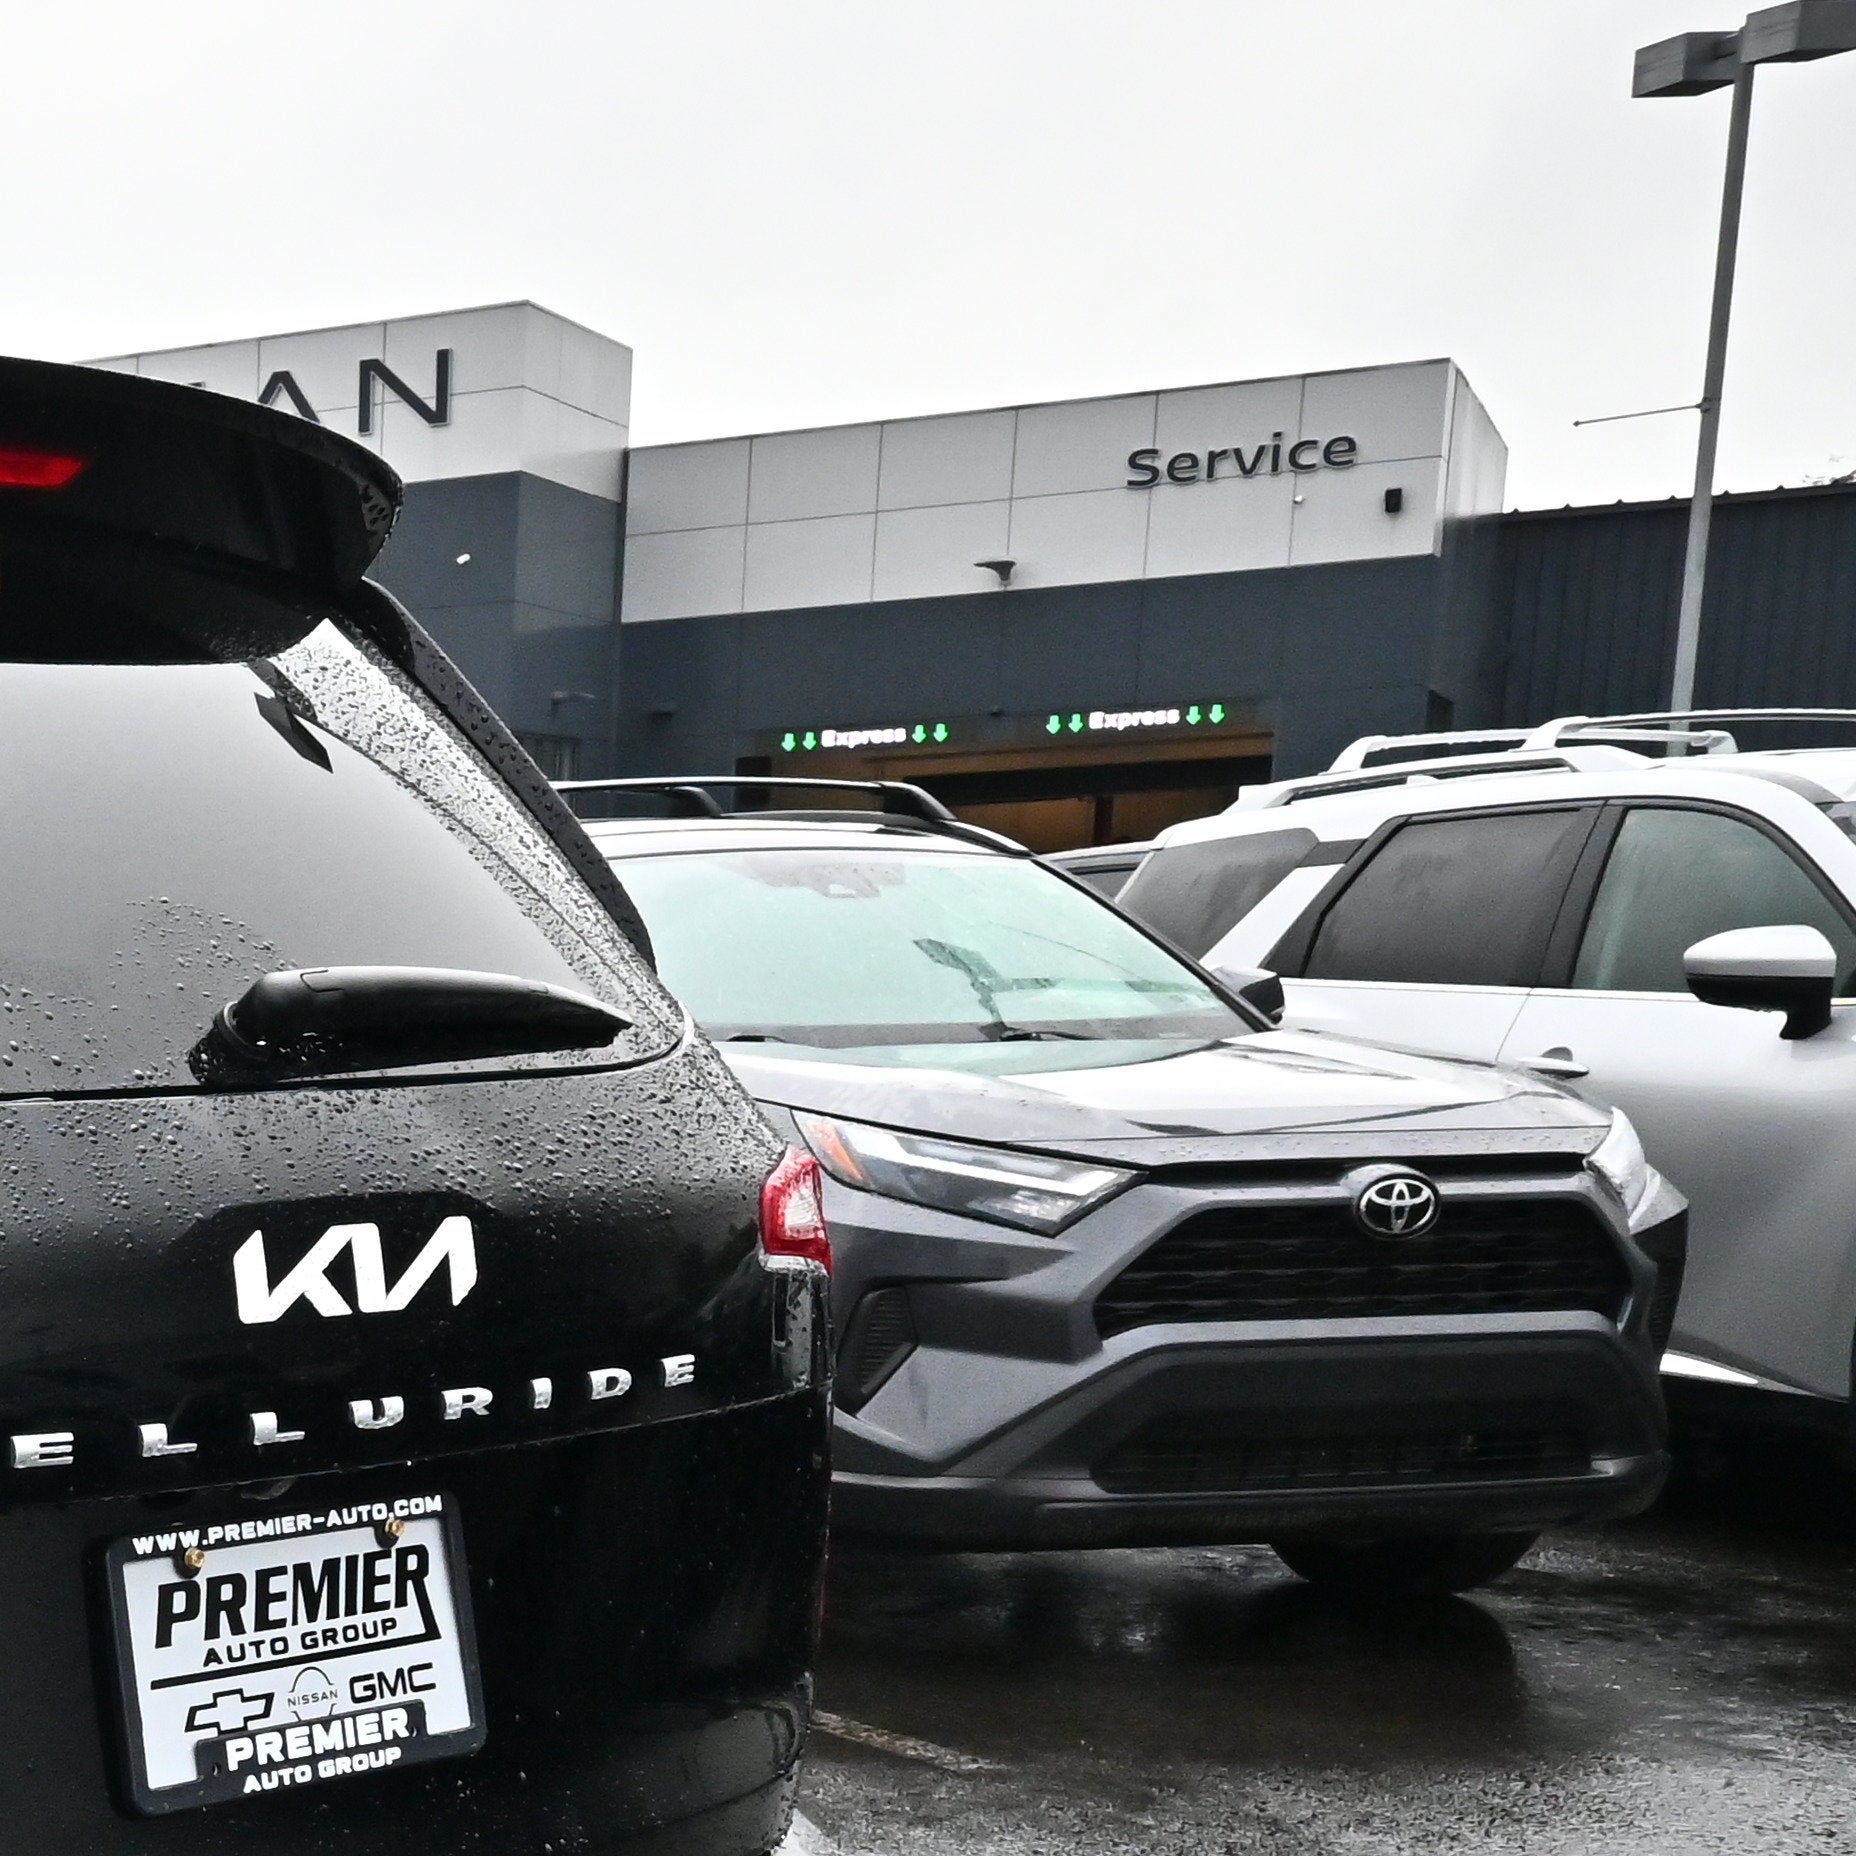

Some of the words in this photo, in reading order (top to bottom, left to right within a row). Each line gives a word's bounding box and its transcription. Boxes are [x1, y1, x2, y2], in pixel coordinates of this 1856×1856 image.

[1126, 431, 1357, 488] Service
[821, 728, 906, 748] Express
[1089, 709, 1180, 730] Express
[232, 1215, 478, 1324] KIA
[131, 1494, 442, 1555] WWW.PREMIER-AUTO.COM
[155, 1543, 436, 1649] PREMIER
[203, 1636, 289, 1667] AUTO
[300, 1617, 397, 1650] GROUP
[287, 1689, 339, 1708] NISSAN
[349, 1662, 437, 1704] GMC
[225, 1707, 410, 1772] PREMIER
[243, 1764, 312, 1794] AUTO
[317, 1746, 402, 1779] GROUP
